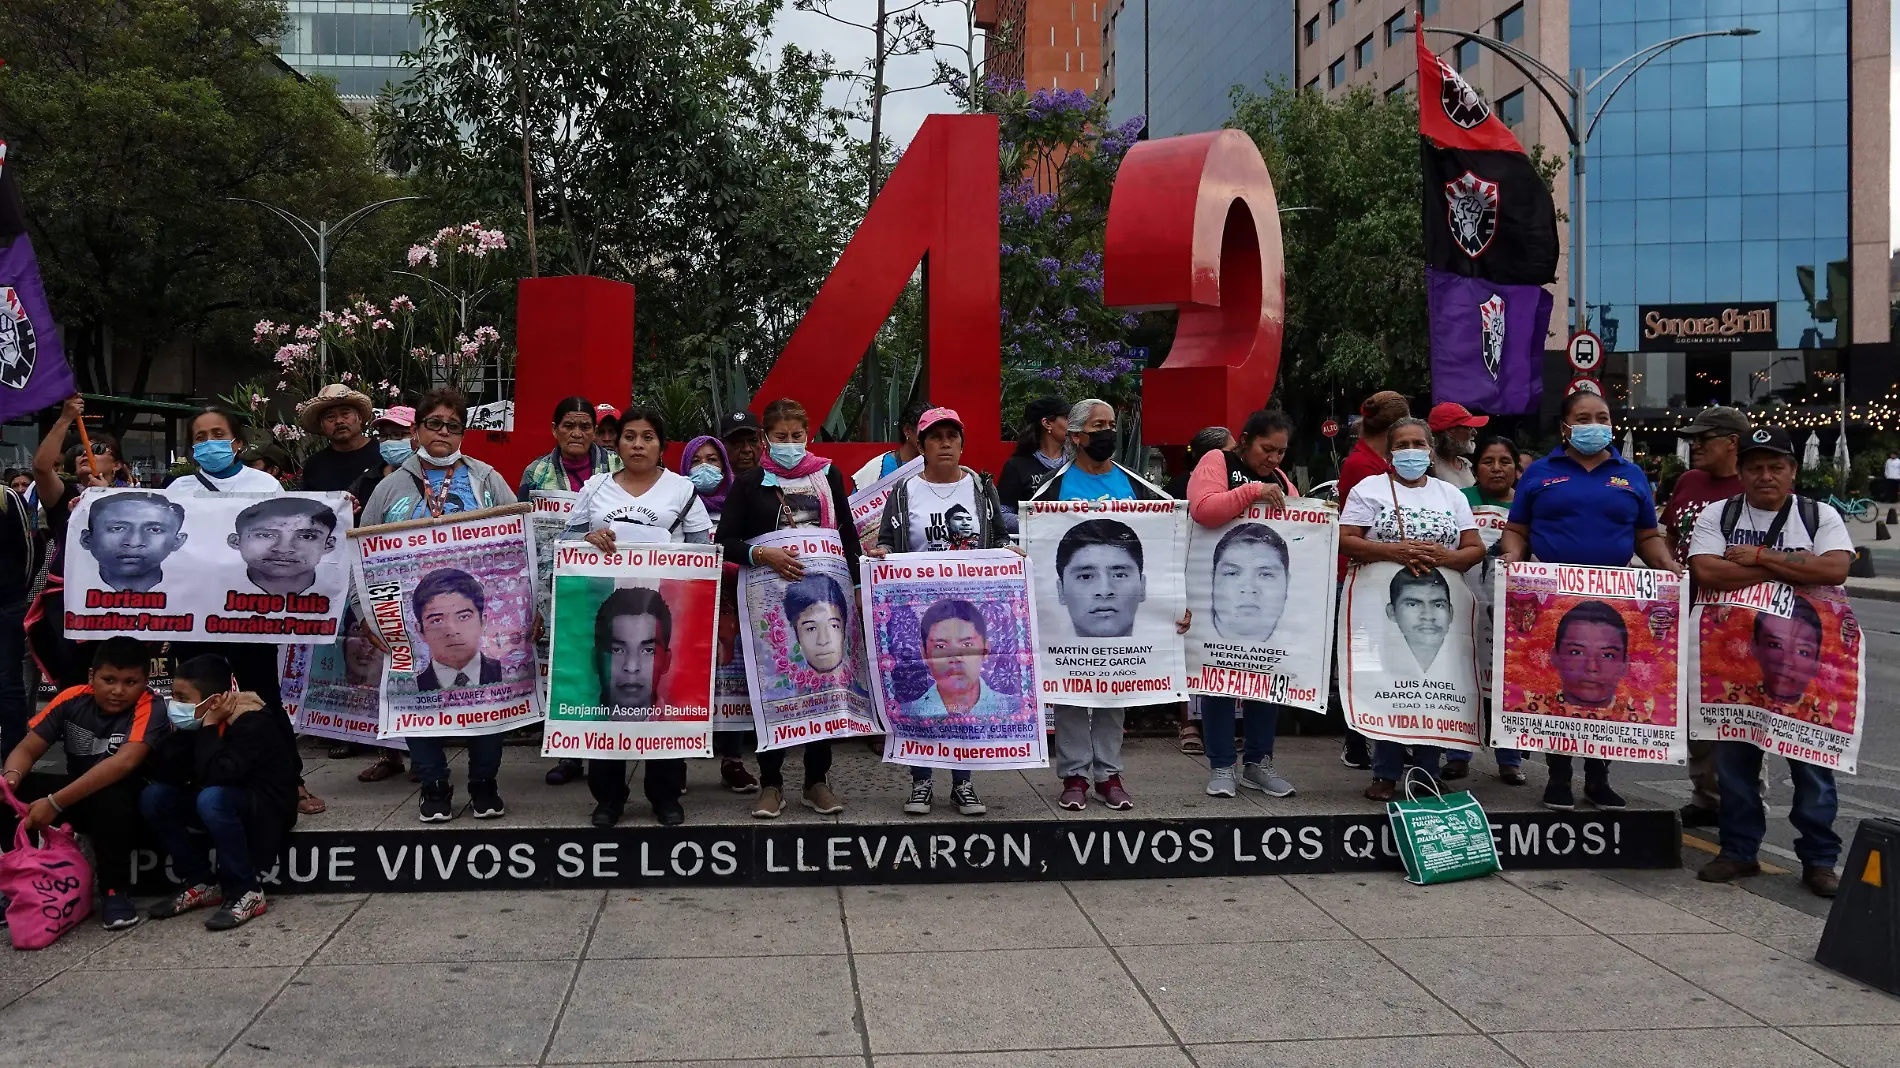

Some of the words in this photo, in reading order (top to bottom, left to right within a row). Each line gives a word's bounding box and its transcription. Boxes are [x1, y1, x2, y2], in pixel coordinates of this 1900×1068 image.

[1644, 311, 1720, 340] Sonora
[1323, 424, 1338, 433] ALTO
[532, 497, 560, 513] ¡Vivo
[603, 505, 635, 524] FRENTE
[636, 506, 660, 523] UNIDO
[851, 504, 870, 519] ivo
[869, 496, 884, 510] se
[1073, 501, 1089, 513] se
[1093, 501, 1107, 513] o
[1111, 500, 1175, 514] llevaron!
[1247, 506, 1260, 519] lo
[930, 512, 943, 526] VI
[362, 535, 402, 558] ¡Vivo
[407, 533, 428, 547] se
[432, 529, 448, 544] lo
[452, 518, 522, 542] llevaron!
[924, 525, 947, 545] VOS
[803, 540, 818, 554] lo
[557, 547, 599, 569] ¡Vivo
[603, 551, 623, 566] se
[627, 550, 643, 566] lo
[648, 550, 719, 569] llevaron!
[873, 564, 913, 584] ¡Vivo
[917, 566, 935, 579] se
[938, 563, 954, 578] lo
[957, 560, 1023, 578] llevaron!
[367, 581, 401, 601] 43!
[1558, 567, 1585, 592] NOS
[1588, 569, 1636, 596] FALTAN
[1635, 569, 1658, 600] 43!
[85, 588, 167, 610] Doriam
[224, 589, 285, 614] Jorge
[285, 592, 330, 614] Luis
[1771, 583, 1795, 617] 43!
[64, 611, 138, 632] González
[138, 612, 195, 633] Parral
[204, 614, 283, 635] González
[283, 616, 337, 636] Parral
[373, 600, 409, 643] FALTAN
[391, 645, 413, 671] NOS
[1048, 645, 1089, 655] MARTÍN
[1091, 645, 1153, 656] GETSEMANY
[1203, 642, 1247, 653] MIGUEL
[1249, 645, 1290, 657] ÁNGEL
[1210, 651, 1282, 664] HERNÁNDEZ
[1055, 656, 1107, 667] SÁNCHEZ
[1109, 655, 1147, 666] GARCÍA
[1216, 659, 1275, 671] MARTÍNEZ
[1112, 669, 1137, 677] AÑOS
[1186, 676, 1200, 689] on
[1043, 679, 1059, 693] on
[1062, 678, 1093, 694] VIDA
[1096, 678, 1108, 694] lo
[1111, 676, 1171, 696] queremos!
[1200, 665, 1226, 692] NOS
[1227, 670, 1271, 699] FALTAN
[1269, 673, 1290, 704] 43!
[1394, 680, 1420, 689] LUIS
[1422, 679, 1456, 691] ÁNGEL
[416, 695, 443, 705] JORGE
[490, 686, 513, 697] NAVA
[1374, 691, 1422, 699] ABARCA
[1425, 691, 1467, 704] CARRILLO
[396, 713, 435, 732] ¡Vivo
[439, 711, 453, 726] lo
[456, 699, 531, 728] queremos!
[558, 703, 610, 717] Benjamin
[612, 704, 662, 716] Ascencio
[664, 704, 708, 716] Bautista
[721, 703, 753, 718] quere
[775, 702, 798, 714] JORGE
[1437, 703, 1460, 713] AÑOS
[306, 710, 331, 727] ¡Vivo
[333, 714, 344, 728] lo
[345, 719, 380, 733] quere
[774, 724, 807, 744] ¡Vivo
[809, 720, 821, 735] lo
[825, 717, 874, 735] queremos!
[989, 723, 1034, 733] GUERRERO
[1358, 712, 1384, 727] ¡Con
[1388, 714, 1420, 729] VIDA
[1422, 715, 1434, 729] lo
[1437, 718, 1476, 736] queremos!
[1501, 714, 1542, 728] CHRISTIAN
[1544, 720, 1582, 732] ALFONSO
[1583, 722, 1630, 736] RODRÍGUEZ
[1633, 727, 1676, 740] TELUMBRE
[1699, 706, 1745, 718] CHRISTIAN
[1811, 728, 1850, 748] TELUMBRE
[546, 731, 580, 750] ¡Con
[584, 732, 615, 750] Vida
[618, 733, 632, 750] lo
[635, 732, 707, 755] queremos!
[1503, 724, 1517, 735] Hijo
[1532, 726, 1567, 738] Clemente
[1577, 732, 1589, 740] Luz
[1641, 737, 1649, 746] 19
[1652, 740, 1670, 748] años
[1703, 716, 1717, 726] Hijo
[1817, 740, 1824, 748] 19
[1827, 744, 1843, 754] años
[1717, 724, 1746, 741] ¡Con
[1777, 740, 1841, 767] queremos!
[900, 740, 935, 757] ¡Vivo
[938, 742, 950, 757] lo
[953, 742, 1031, 761] queremos!
[1515, 733, 1543, 749] ¡Con
[1550, 737, 1579, 754] VIDA
[1583, 740, 1595, 755] lo
[1600, 745, 1669, 761] queremos!
[376, 843, 536, 880] VIVOS
[556, 842, 620, 878] SE
[640, 840, 738, 877] LOS
[765, 832, 1049, 874] LLEVARON,
[1068, 827, 1215, 866] VIVOS
[1233, 825, 1323, 863] LOS
